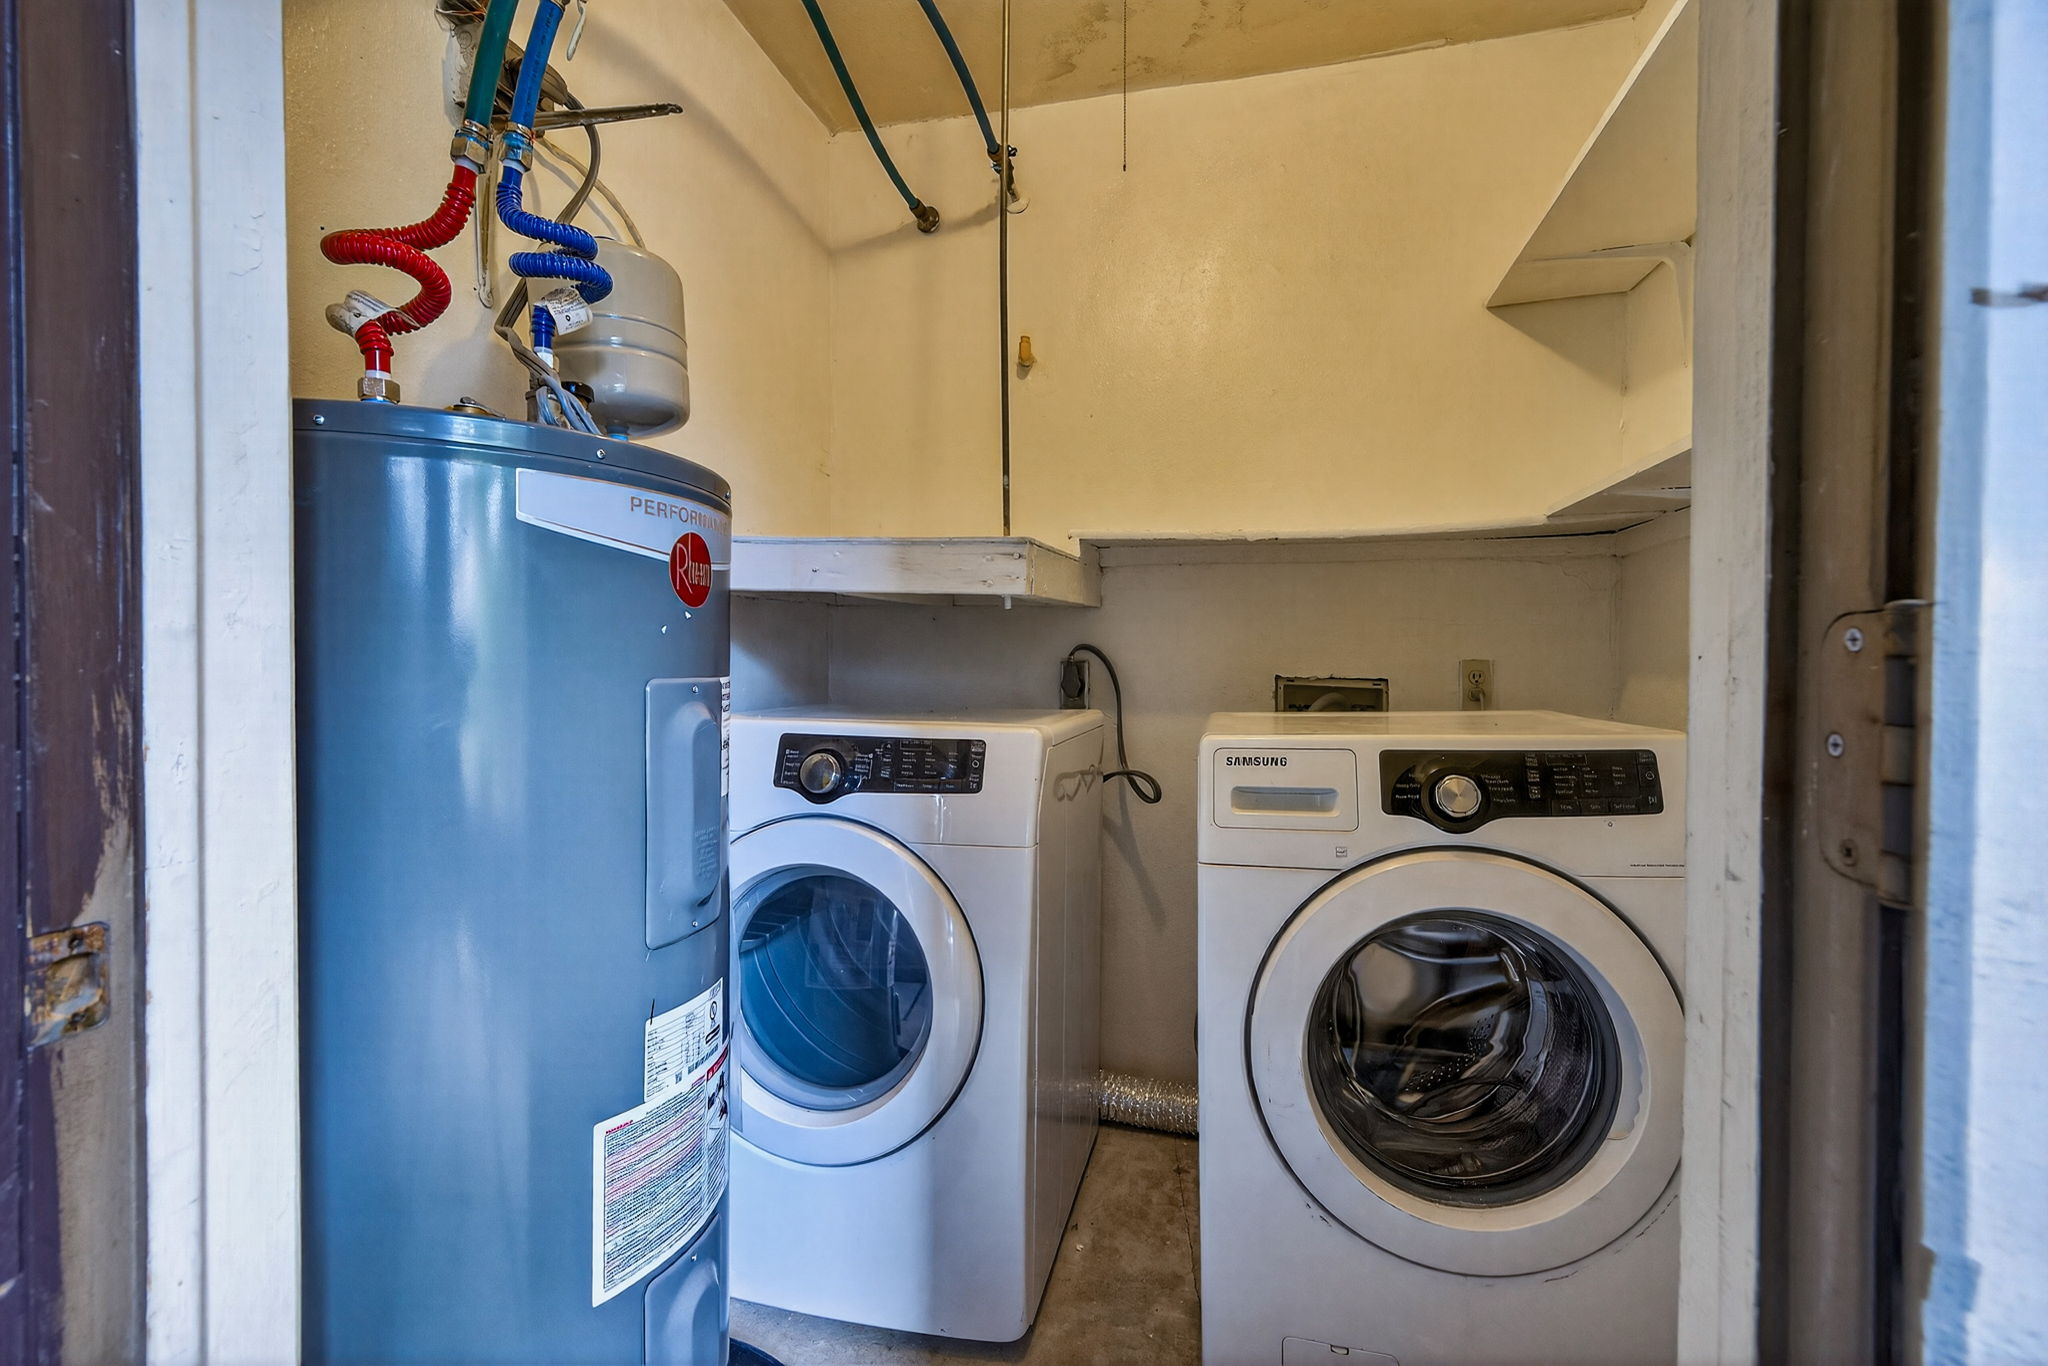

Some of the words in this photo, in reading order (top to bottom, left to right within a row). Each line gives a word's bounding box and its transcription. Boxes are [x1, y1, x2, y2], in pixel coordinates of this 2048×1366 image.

[630, 496, 728, 535] PERFOR
[676, 532, 711, 594] Rheem
[1226, 756, 1288, 767] SAMSUNG
